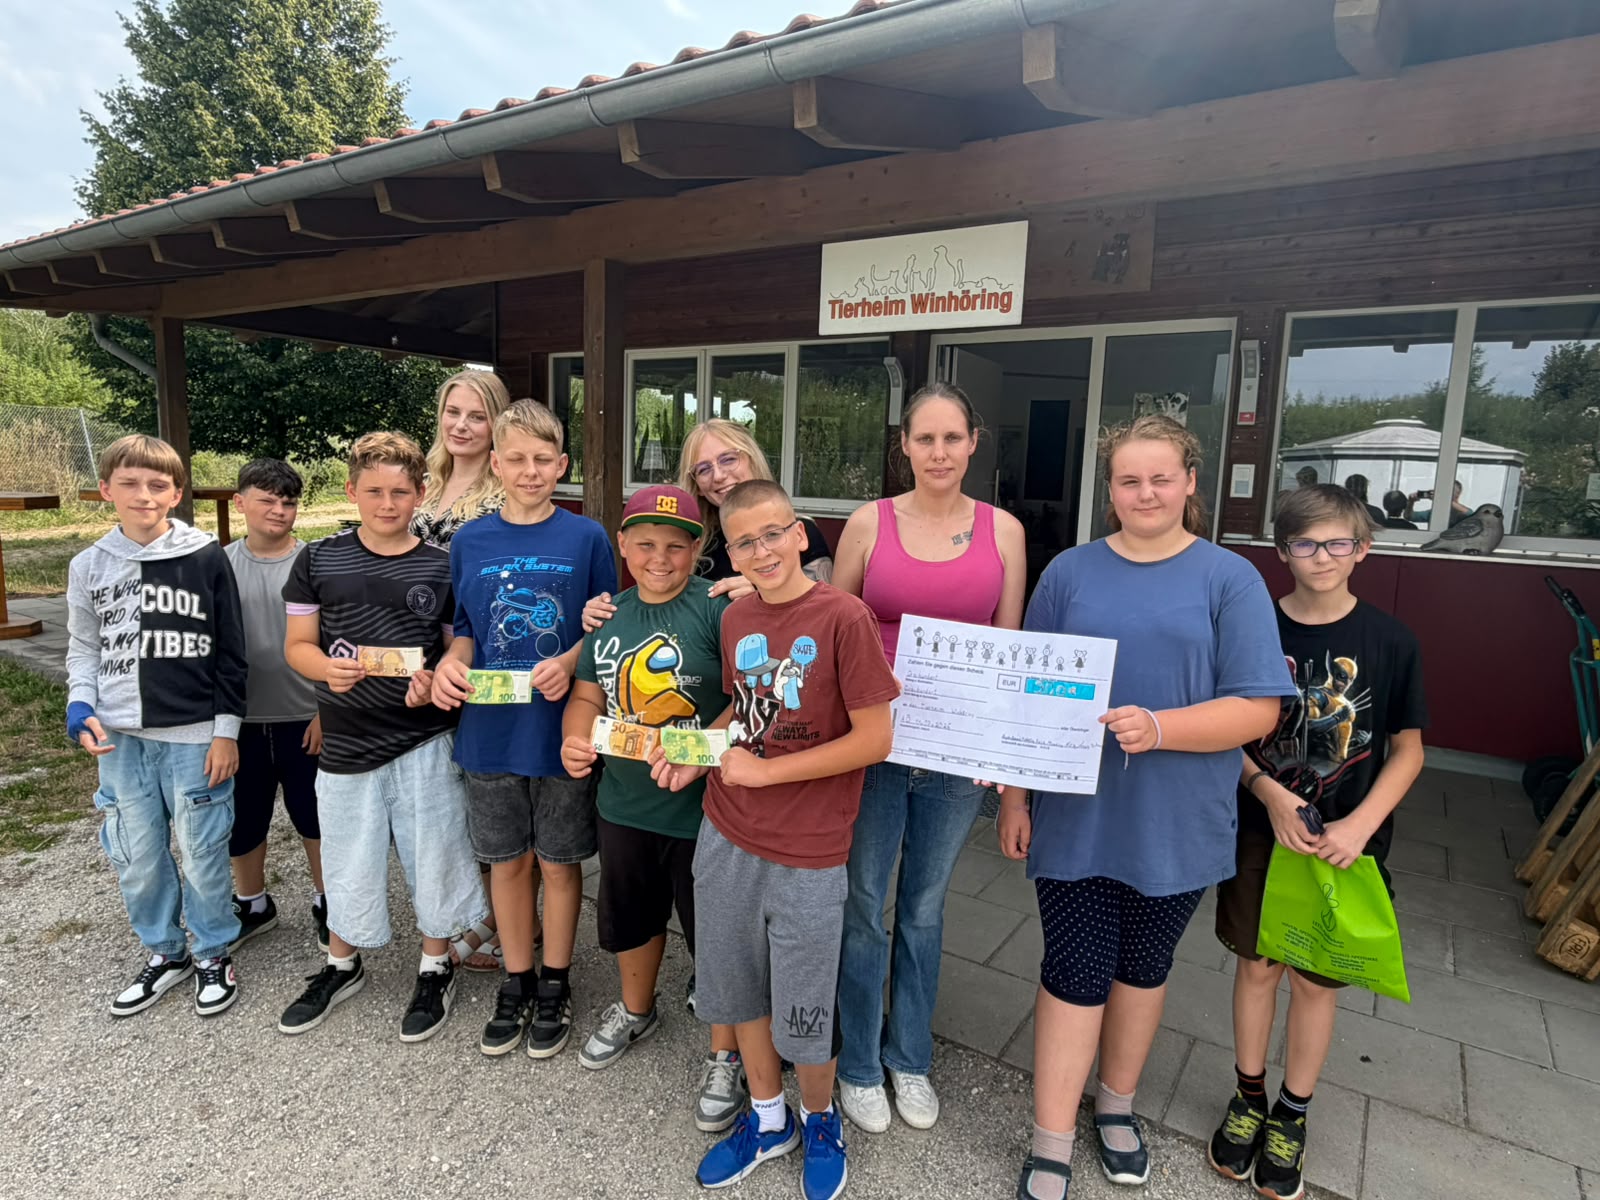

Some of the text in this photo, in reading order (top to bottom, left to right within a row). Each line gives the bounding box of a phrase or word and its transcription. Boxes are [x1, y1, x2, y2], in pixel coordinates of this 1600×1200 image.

[828, 288, 1013, 319] Tierheim Winhöring
[513, 557, 539, 565] THE
[480, 563, 575, 575] SOLAR SYSTEM
[141, 584, 207, 620] COOL
[1002, 679, 1017, 688] EUR
[499, 693, 516, 702] 100
[611, 722, 627, 734] 50
[696, 754, 715, 764] 100
